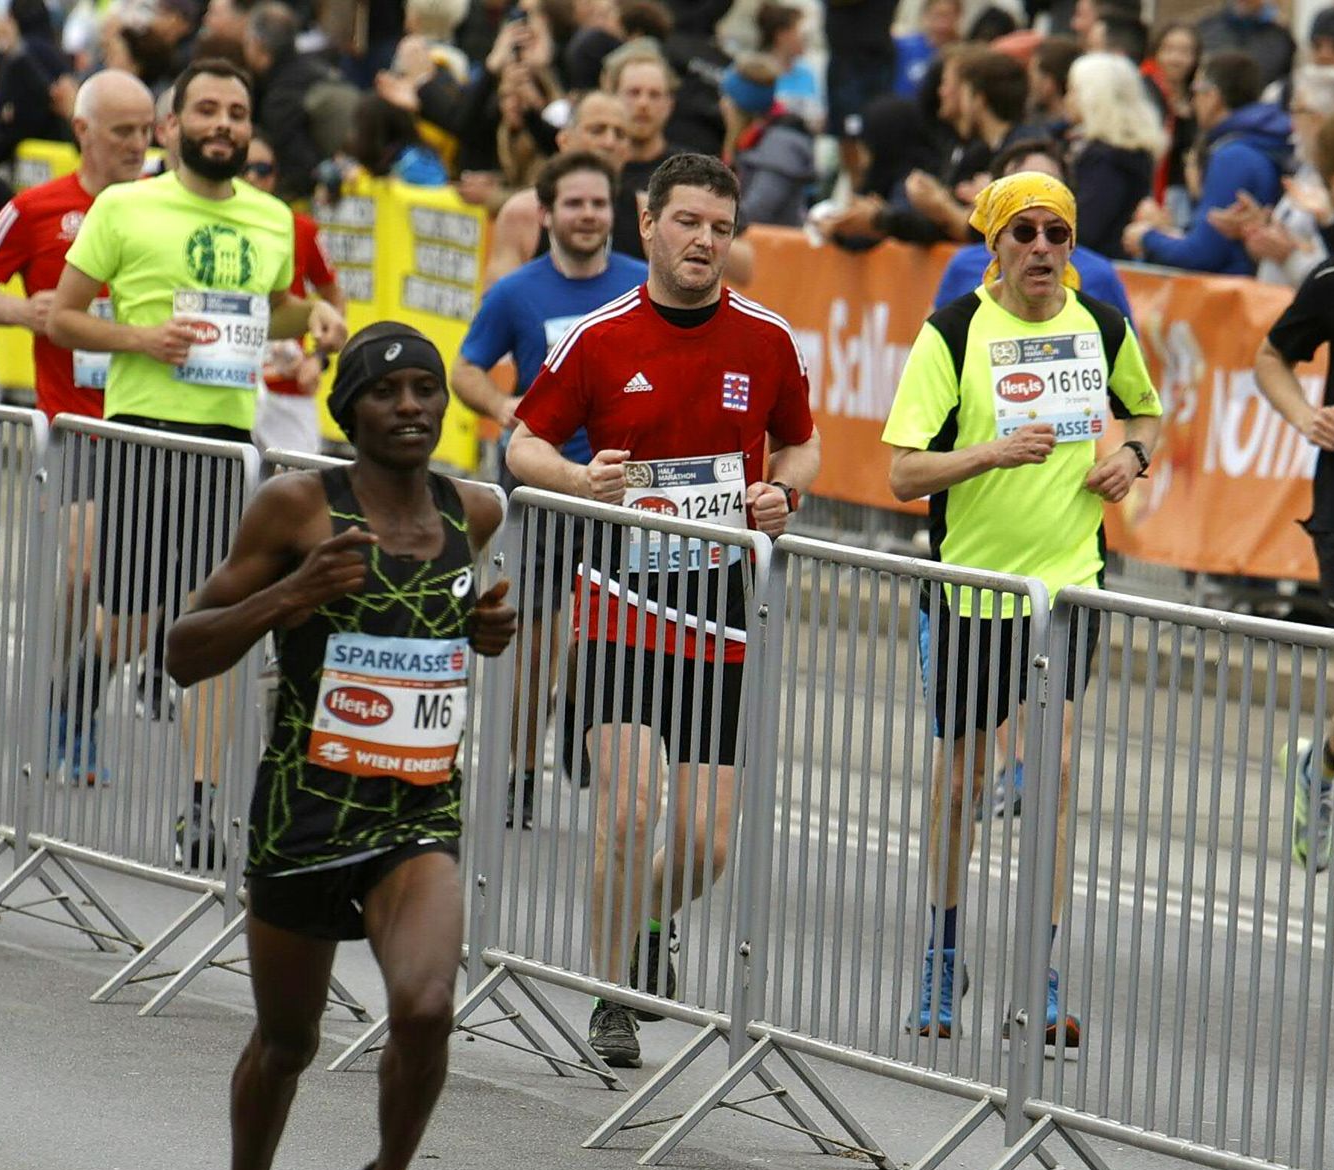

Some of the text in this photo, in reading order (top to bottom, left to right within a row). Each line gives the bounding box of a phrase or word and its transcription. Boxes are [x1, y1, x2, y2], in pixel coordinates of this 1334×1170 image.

[999, 368, 1103, 397] Hervis 16169
[1002, 420, 1089, 437] SASSE
[632, 490, 744, 520] Heris 12474
[334, 644, 450, 673] SPARKASSE
[329, 691, 453, 730] Hervis M6
[355, 749, 400, 771] WIEN
